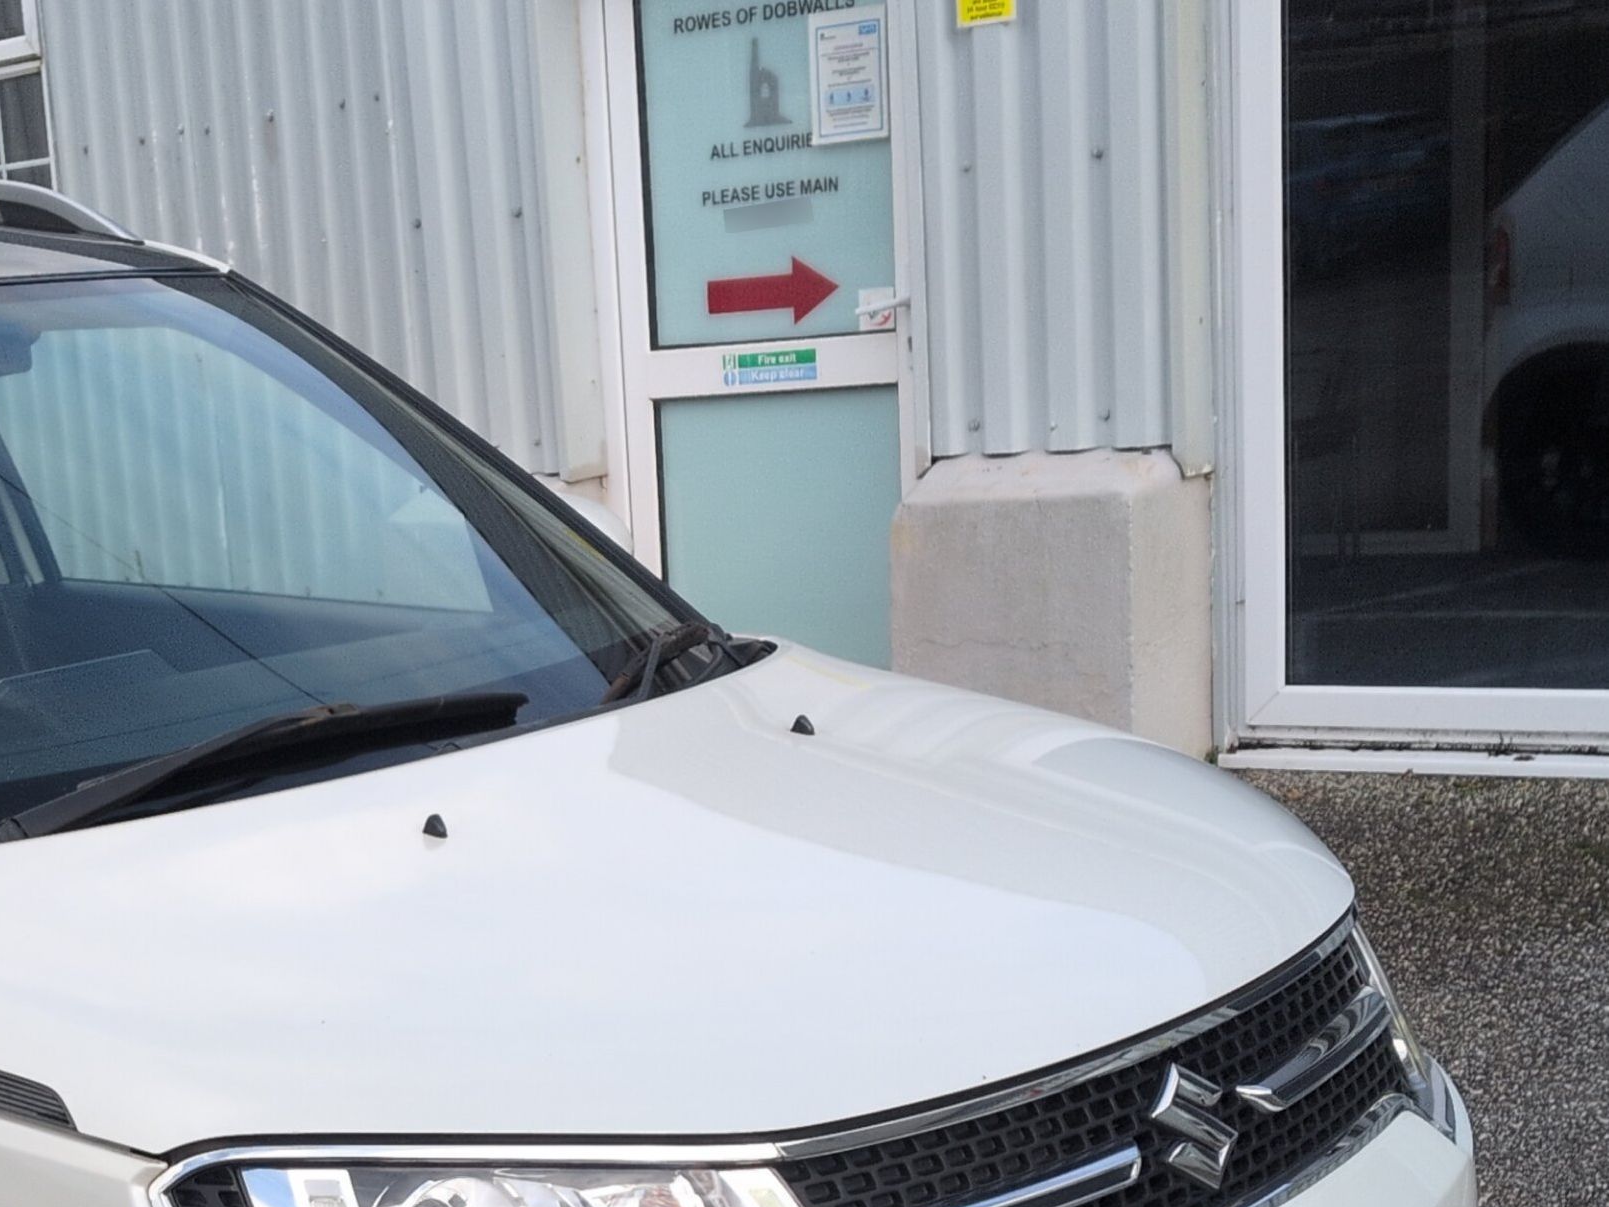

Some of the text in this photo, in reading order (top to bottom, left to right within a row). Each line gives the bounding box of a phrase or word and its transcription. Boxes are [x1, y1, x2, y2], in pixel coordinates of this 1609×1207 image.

[673, 11, 732, 34] ROWES
[736, 6, 759, 24] OF
[710, 132, 813, 160] ALL ENQUIRIE
[702, 176, 839, 206] PLEASE USE MAIN
[758, 354, 777, 366] Fire
